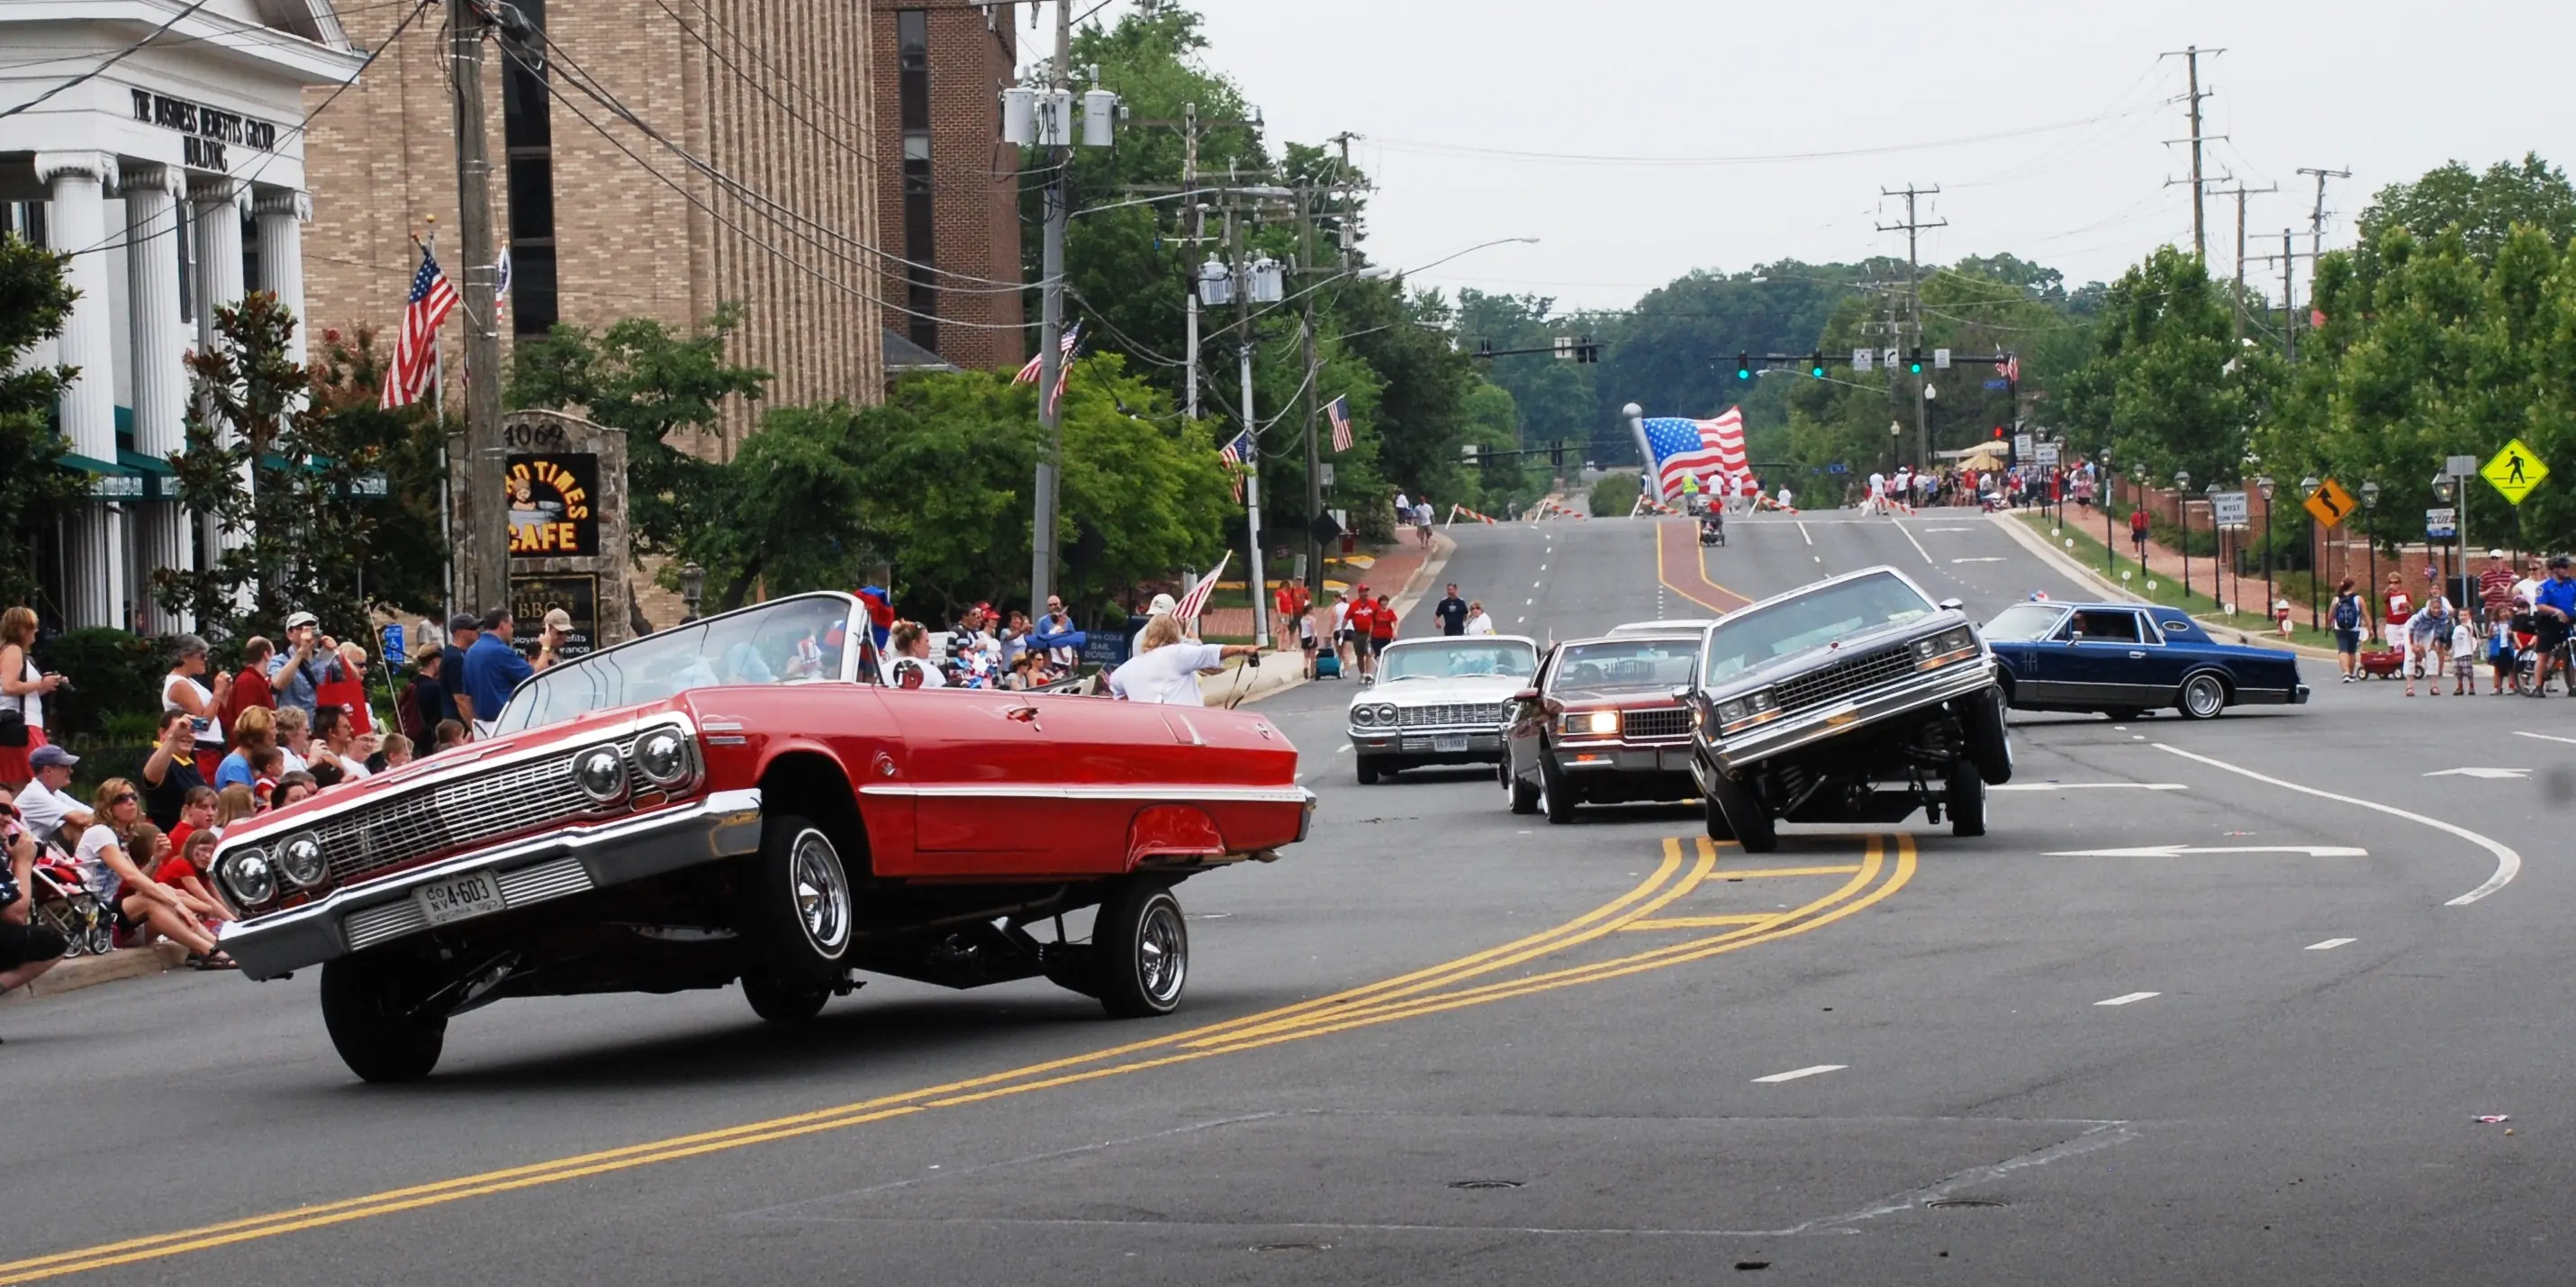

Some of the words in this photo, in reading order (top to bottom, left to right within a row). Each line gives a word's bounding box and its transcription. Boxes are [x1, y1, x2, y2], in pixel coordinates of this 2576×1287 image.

[131, 87, 152, 122] THE
[154, 95, 198, 134] BUSINESS
[200, 106, 243, 145] BENEFITS
[245, 118, 276, 153] GROUP
[183, 135, 228, 173] BUILDING
[533, 461, 588, 520] TIMES
[2222, 504, 2240, 512] MUST
[509, 521, 578, 552] CAFE
[565, 633, 587, 643] efits
[1085, 650, 1116, 659] BONDS
[430, 900, 448, 912] NV
